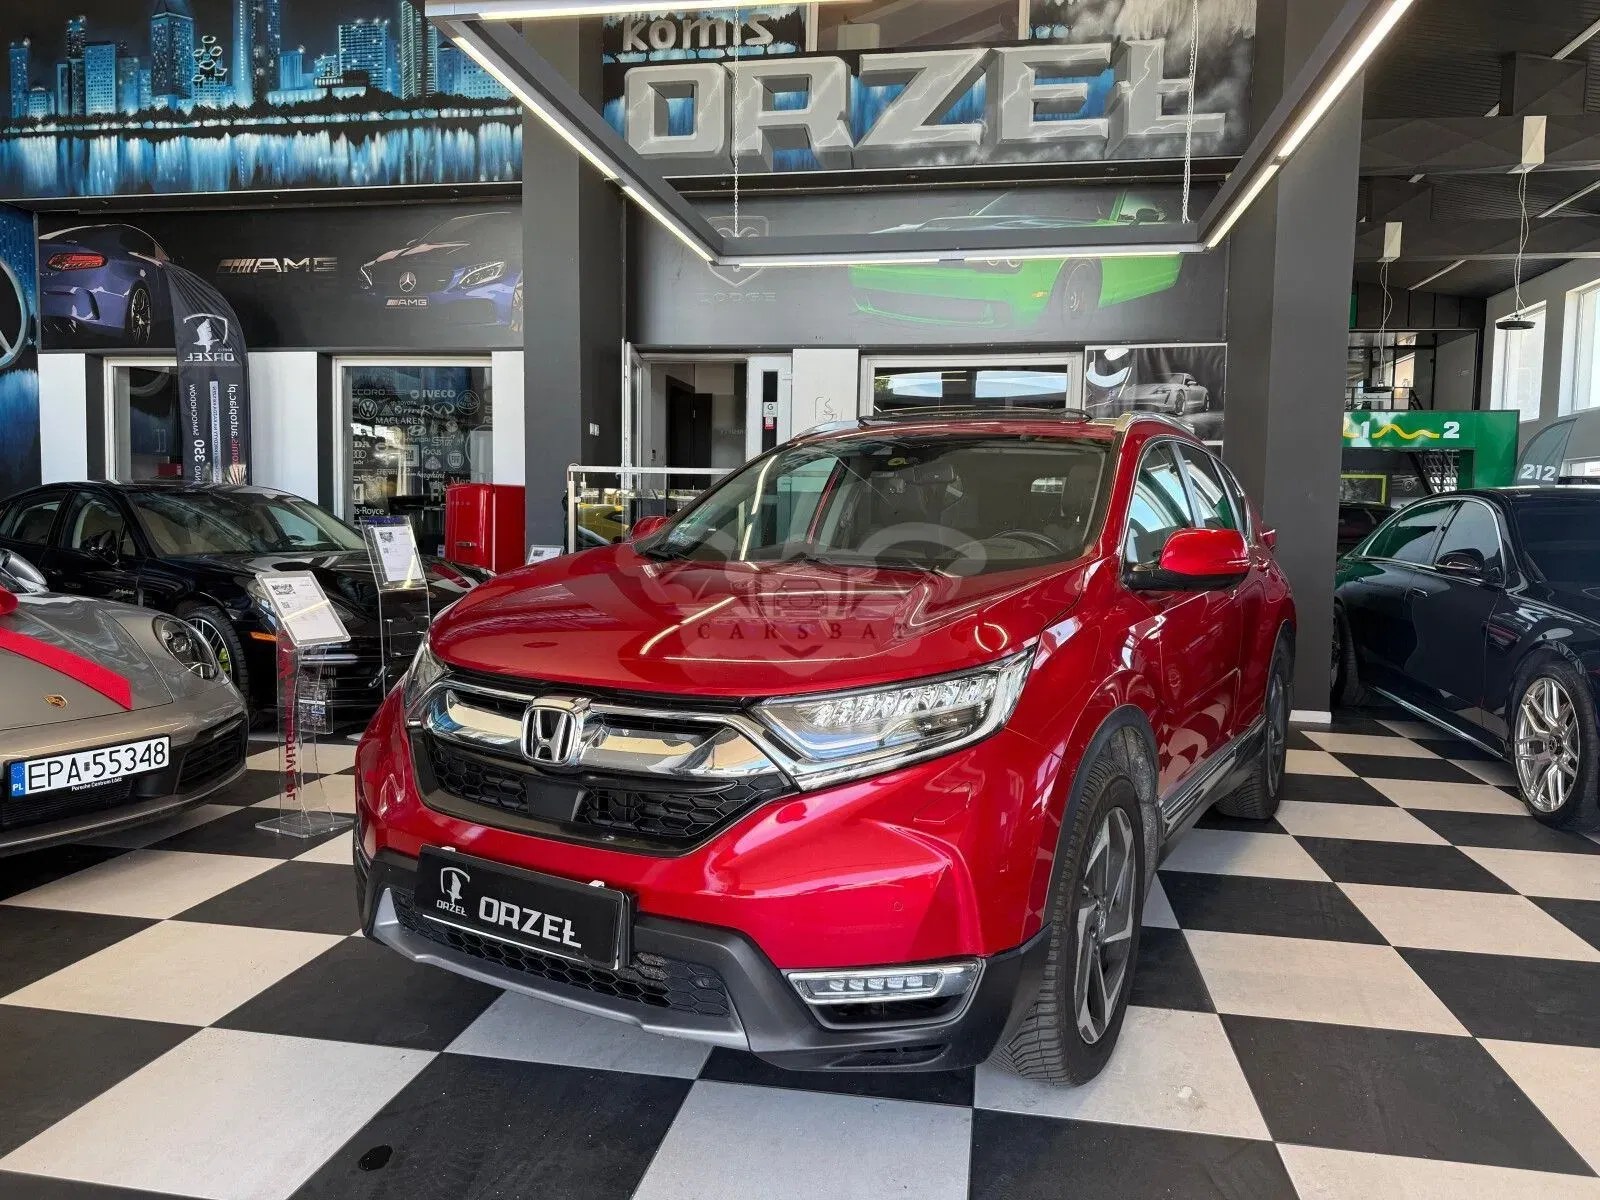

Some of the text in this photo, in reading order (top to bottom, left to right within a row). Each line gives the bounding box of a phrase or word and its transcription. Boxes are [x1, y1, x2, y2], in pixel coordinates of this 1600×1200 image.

[624, 38, 1226, 164] ORZEŁ
[250, 256, 338, 273] AMG
[399, 298, 428, 306] AMG
[422, 389, 456, 398] IVECO
[1360, 421, 1460, 439] 1 2
[1520, 464, 1555, 482] 212
[28, 741, 166, 791] EPA 55348
[12, 783, 24, 791] PL
[436, 899, 468, 917] ORZEŁ
[478, 895, 582, 949] ORZEŁ
